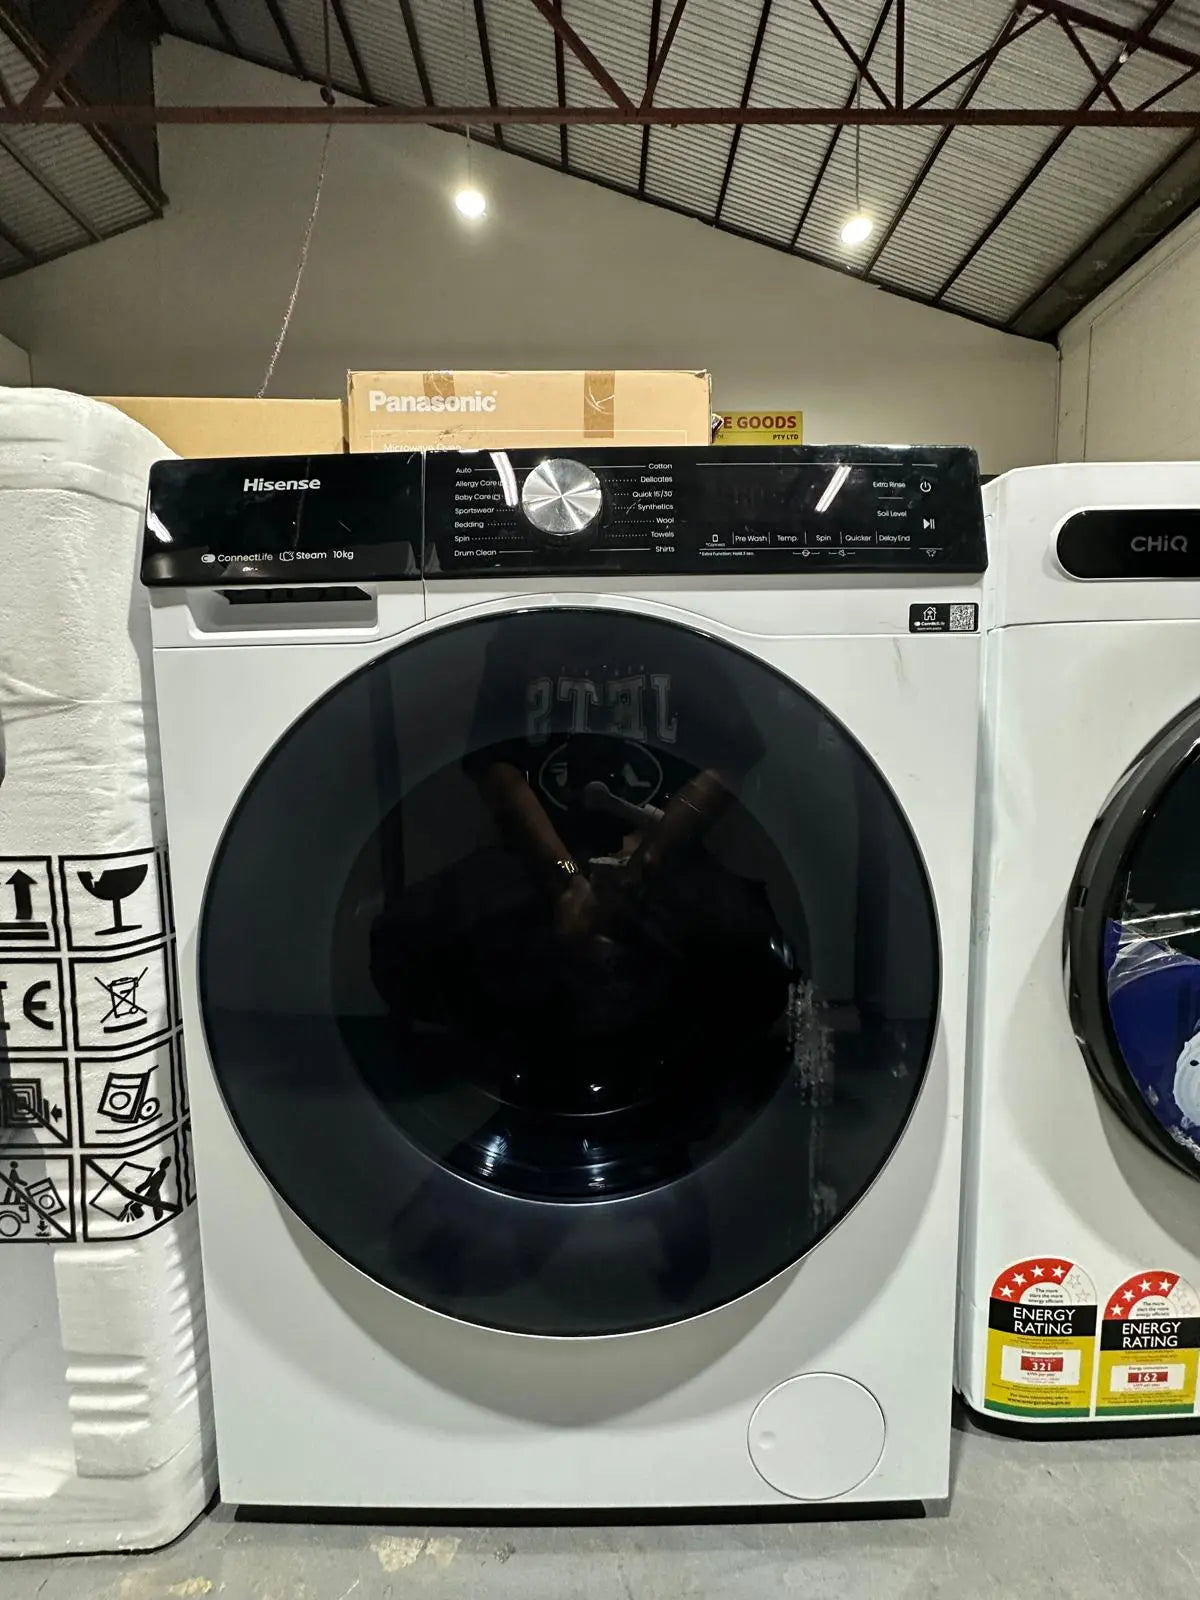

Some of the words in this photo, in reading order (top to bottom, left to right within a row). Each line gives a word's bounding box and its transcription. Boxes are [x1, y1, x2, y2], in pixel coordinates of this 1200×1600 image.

[369, 390, 496, 412] Panasonic
[737, 416, 796, 428] GOODS
[243, 478, 321, 492] Hisense
[1130, 536, 1188, 552] CHiQ
[218, 553, 273, 562] ConnectLife
[296, 551, 326, 560] Steam
[332, 550, 354, 560] 10kg
[1014, 1307, 1076, 1321] ENERGY
[1014, 1321, 1072, 1334] RATING
[1122, 1322, 1181, 1334] ENERGY
[1123, 1336, 1178, 1348] RATING
[1032, 1362, 1051, 1371] 321
[1138, 1373, 1158, 1381] 162
